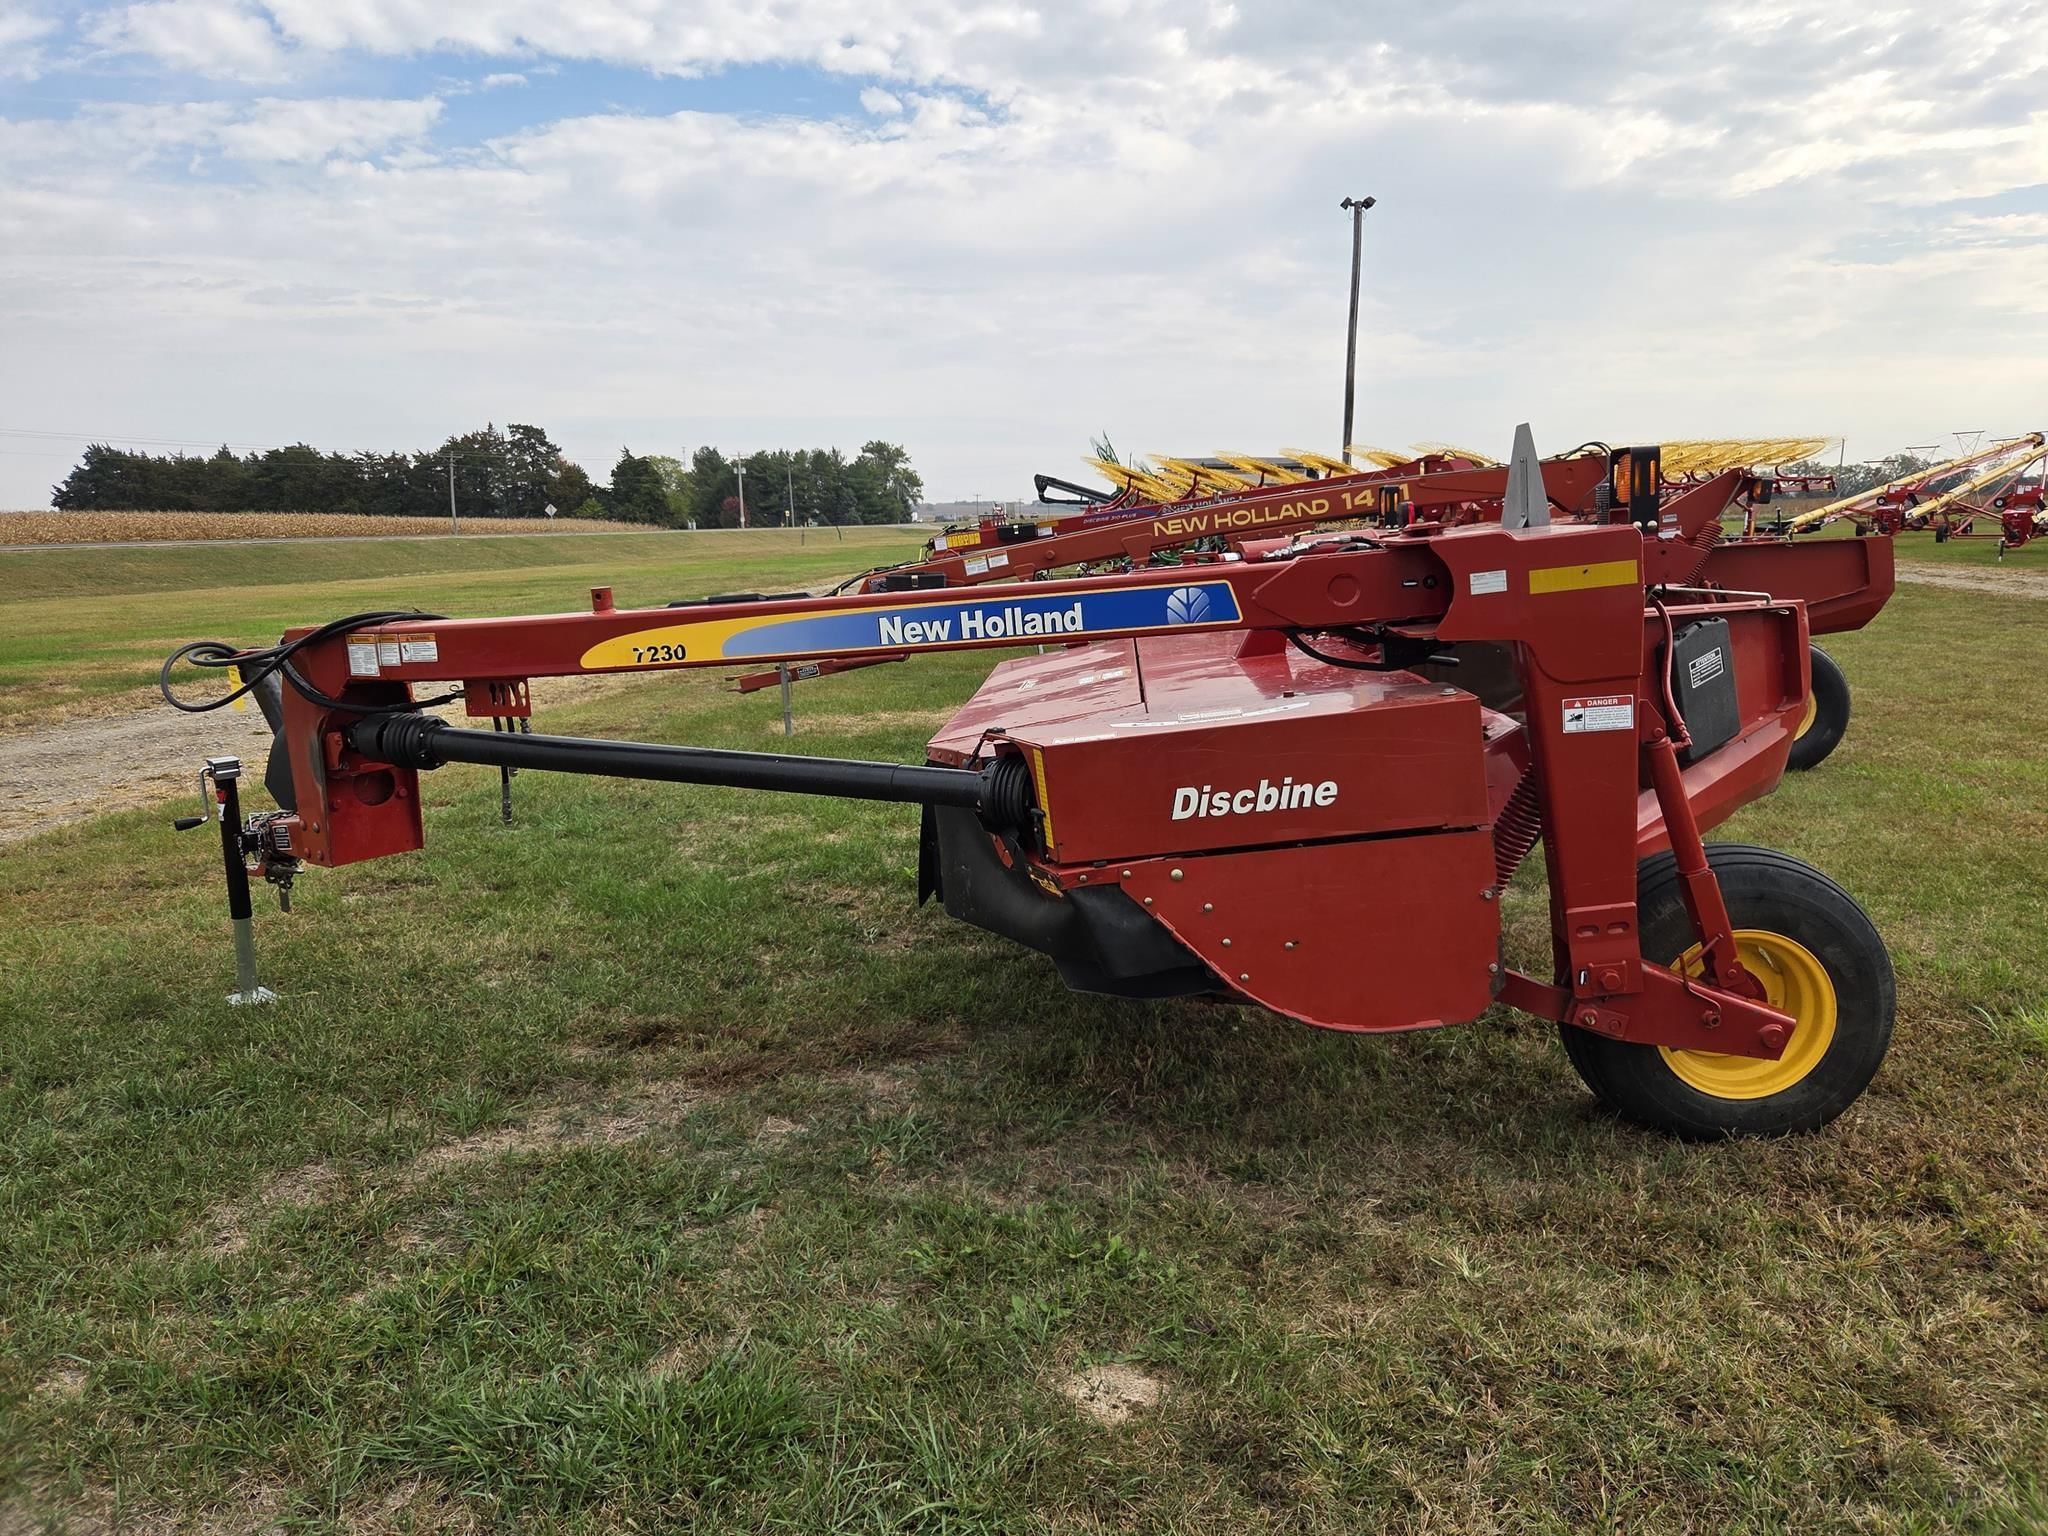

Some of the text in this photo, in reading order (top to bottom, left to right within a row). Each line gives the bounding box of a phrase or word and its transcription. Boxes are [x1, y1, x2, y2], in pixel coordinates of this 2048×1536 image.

[1154, 514, 1209, 537] NEW
[1214, 498, 1330, 529] HOLLAND
[878, 601, 1084, 645] New Holland
[632, 644, 687, 663] 7230
[1587, 698, 1618, 706] DANGER
[1171, 776, 1339, 821] Discbine
